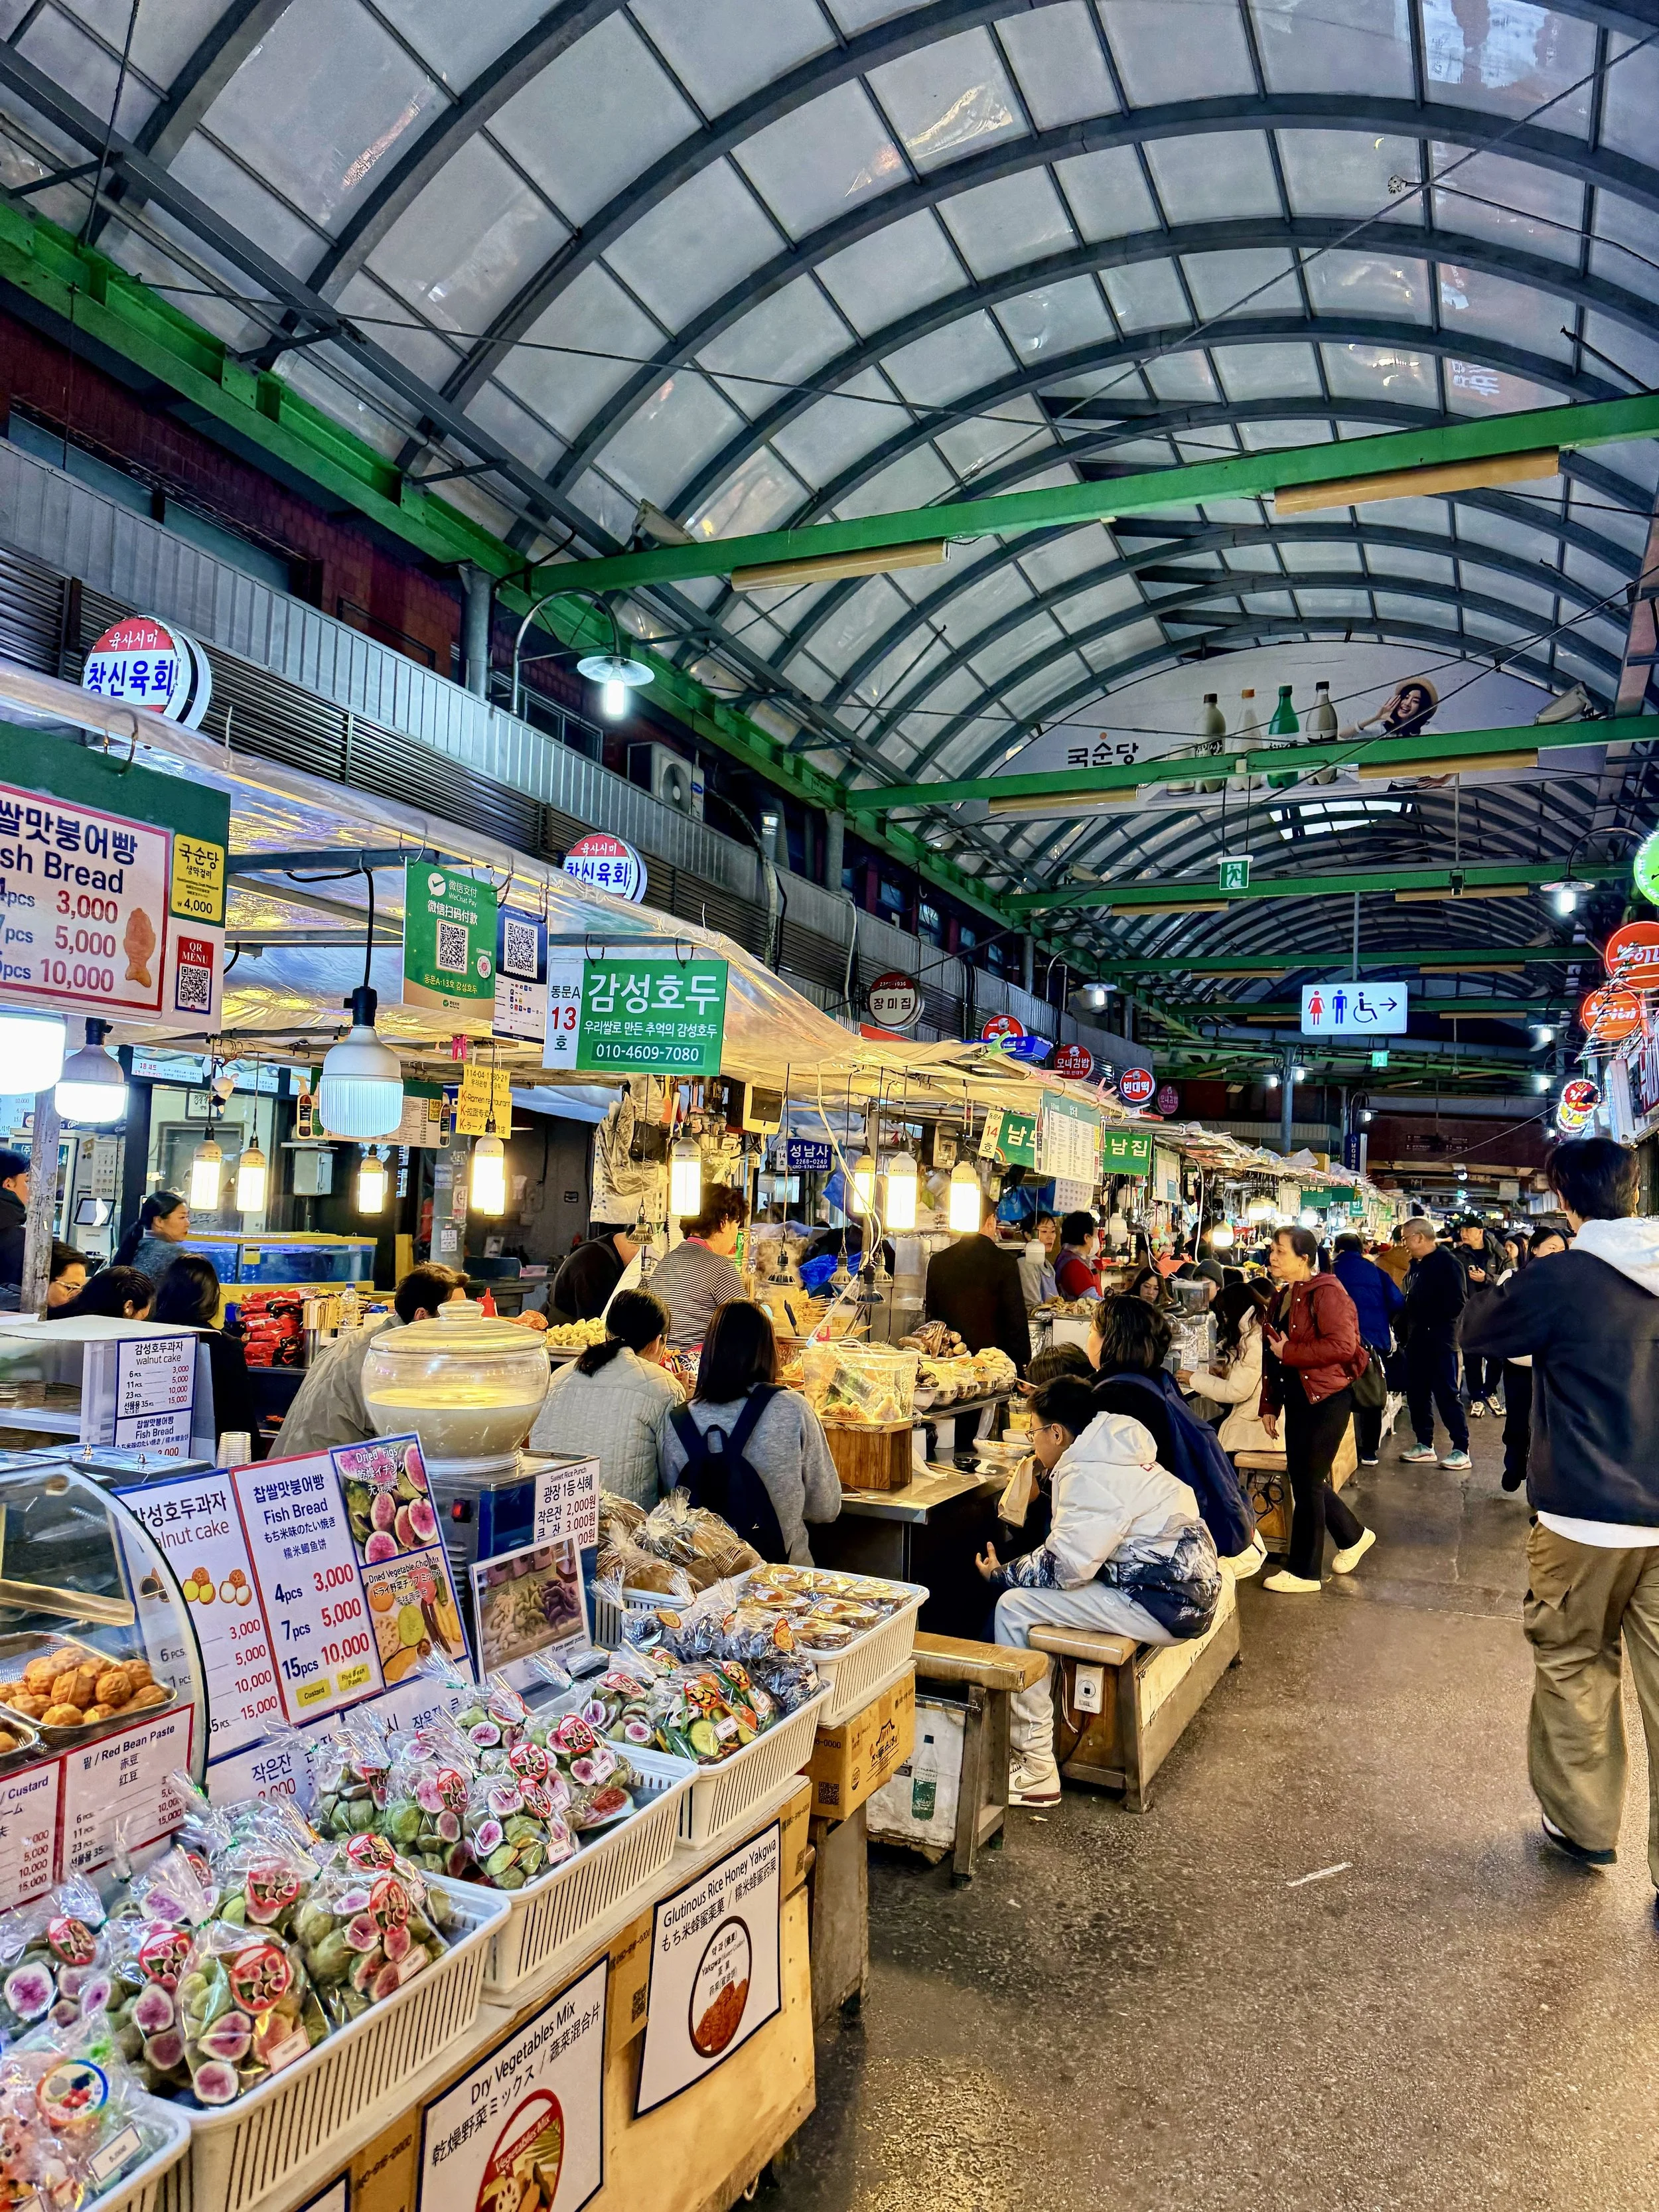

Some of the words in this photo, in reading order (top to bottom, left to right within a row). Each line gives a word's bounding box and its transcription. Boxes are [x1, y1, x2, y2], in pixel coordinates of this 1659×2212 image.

[109, 629, 158, 650] 육사시미
[88, 660, 175, 696] 창신육회
[1068, 742, 1139, 767] 국순당
[179, 843, 220, 870] 국순당
[581, 842, 617, 855] 육사시미
[0, 844, 33, 874] sh
[44, 850, 123, 894] Bread
[186, 865, 212, 880] 생막걸리
[449, 879, 477, 898] 微信支付
[449, 892, 468, 904] WeChat
[56, 890, 118, 924] 3,000
[184, 897, 213, 914] 4,000
[428, 899, 478, 926] 微信扫码付款
[55, 924, 116, 958] 5,000
[189, 941, 202, 952] QR
[182, 950, 209, 964] MENU
[40, 958, 114, 992] 10,000
[551, 986, 581, 999] 동문A
[589, 974, 720, 1015] 감성호두
[874, 997, 910, 1009] 장미집
[551, 1007, 577, 1030] 13
[584, 1021, 622, 1035] 우리쌀로
[624, 1021, 644, 1035] 만든
[644, 1023, 675, 1037] 추억의
[677, 1023, 717, 1038] 감성호두
[555, 1035, 567, 1051] 호
[597, 1043, 699, 1061] 010-4609-7080
[1123, 1081, 1149, 1094] 빈대떡
[485, 1097, 510, 1108] retaurant
[986, 1126, 998, 1138] 14
[790, 1145, 828, 1157] 성남사
[981, 1142, 992, 1153] 호
[1104, 1138, 1148, 1157] 남집
[135, 1341, 183, 1355] 감성호두과자
[136, 1356, 162, 1365] walnut
[163, 1354, 181, 1364] cake
[173, 1365, 189, 1374] 3,000
[172, 1375, 188, 1384] 5,000
[169, 1385, 188, 1394] 10,000
[169, 1396, 187, 1404] 15,000
[137, 1416, 174, 1429] 찹쌀맛붕어빵
[135, 1430, 151, 1439] Fish
[153, 1426, 174, 1436] Bread
[117, 1438, 162, 1449] ち米味のたい焼き
[356, 1449, 378, 1463] Dried
[382, 1447, 397, 1458] Figs
[253, 1474, 325, 1503] 찹쌀맛붕어빵
[543, 1483, 561, 1503] 광장
[563, 1479, 575, 1497] 1등
[577, 1474, 593, 1492] 식혜
[263, 1507, 290, 1525] Fish
[292, 1498, 328, 1518] Bread
[538, 1505, 562, 1524] 작은잔
[567, 1494, 595, 1516] 2,000원
[154, 1527, 193, 1550] alnut
[196, 1520, 230, 1540] cake
[264, 1516, 336, 1543] もち米味のたい焼き
[369, 1572, 385, 1584] Dried
[387, 1564, 415, 1578] Vegetable
[415, 1559, 428, 1569] Chip
[275, 1584, 303, 1605] 4pcs
[313, 1564, 354, 1592] 3,000
[281, 1620, 311, 1641] 7pcs
[321, 1598, 362, 1628] 5,000
[161, 1649, 169, 1662] 6
[230, 1619, 260, 1639] 3,000
[236, 1645, 266, 1666] 5,000
[282, 1657, 319, 1680] 15pcs
[321, 1633, 369, 1666] 10,000
[235, 1670, 271, 1693] 10,000
[305, 1687, 325, 1700] Custard
[211, 1719, 219, 1732] 5
[241, 1696, 277, 1720] 15,000
[84, 1756, 91, 1769] 팥
[102, 1745, 120, 1761] Red
[123, 1735, 147, 1752] Bean
[150, 1726, 175, 1741] Paste
[252, 1753, 291, 1783] 작은잔
[8, 1775, 48, 1799] Custard
[76, 1814, 82, 1824] 6
[158, 1808, 182, 1825] 15,000
[74, 1828, 82, 1839] 11
[24, 1844, 48, 1861] 5,000
[72, 1842, 82, 1853] 23
[19, 1859, 47, 1878] 10,000
[19, 1873, 47, 1892] 15,000
[664, 1891, 706, 1927] Glutinous
[708, 1878, 723, 1899] Rice
[725, 1860, 747, 1883] Honey
[749, 1839, 776, 1868] Yakgwa
[472, 2075, 492, 2105] Dry
[496, 2021, 554, 2083] Vegetables
[557, 2001, 575, 2029] Mix
[432, 2065, 534, 2166] 乾燥野菜ミックス
[549, 2002, 600, 2063] 蔬菜混合片
